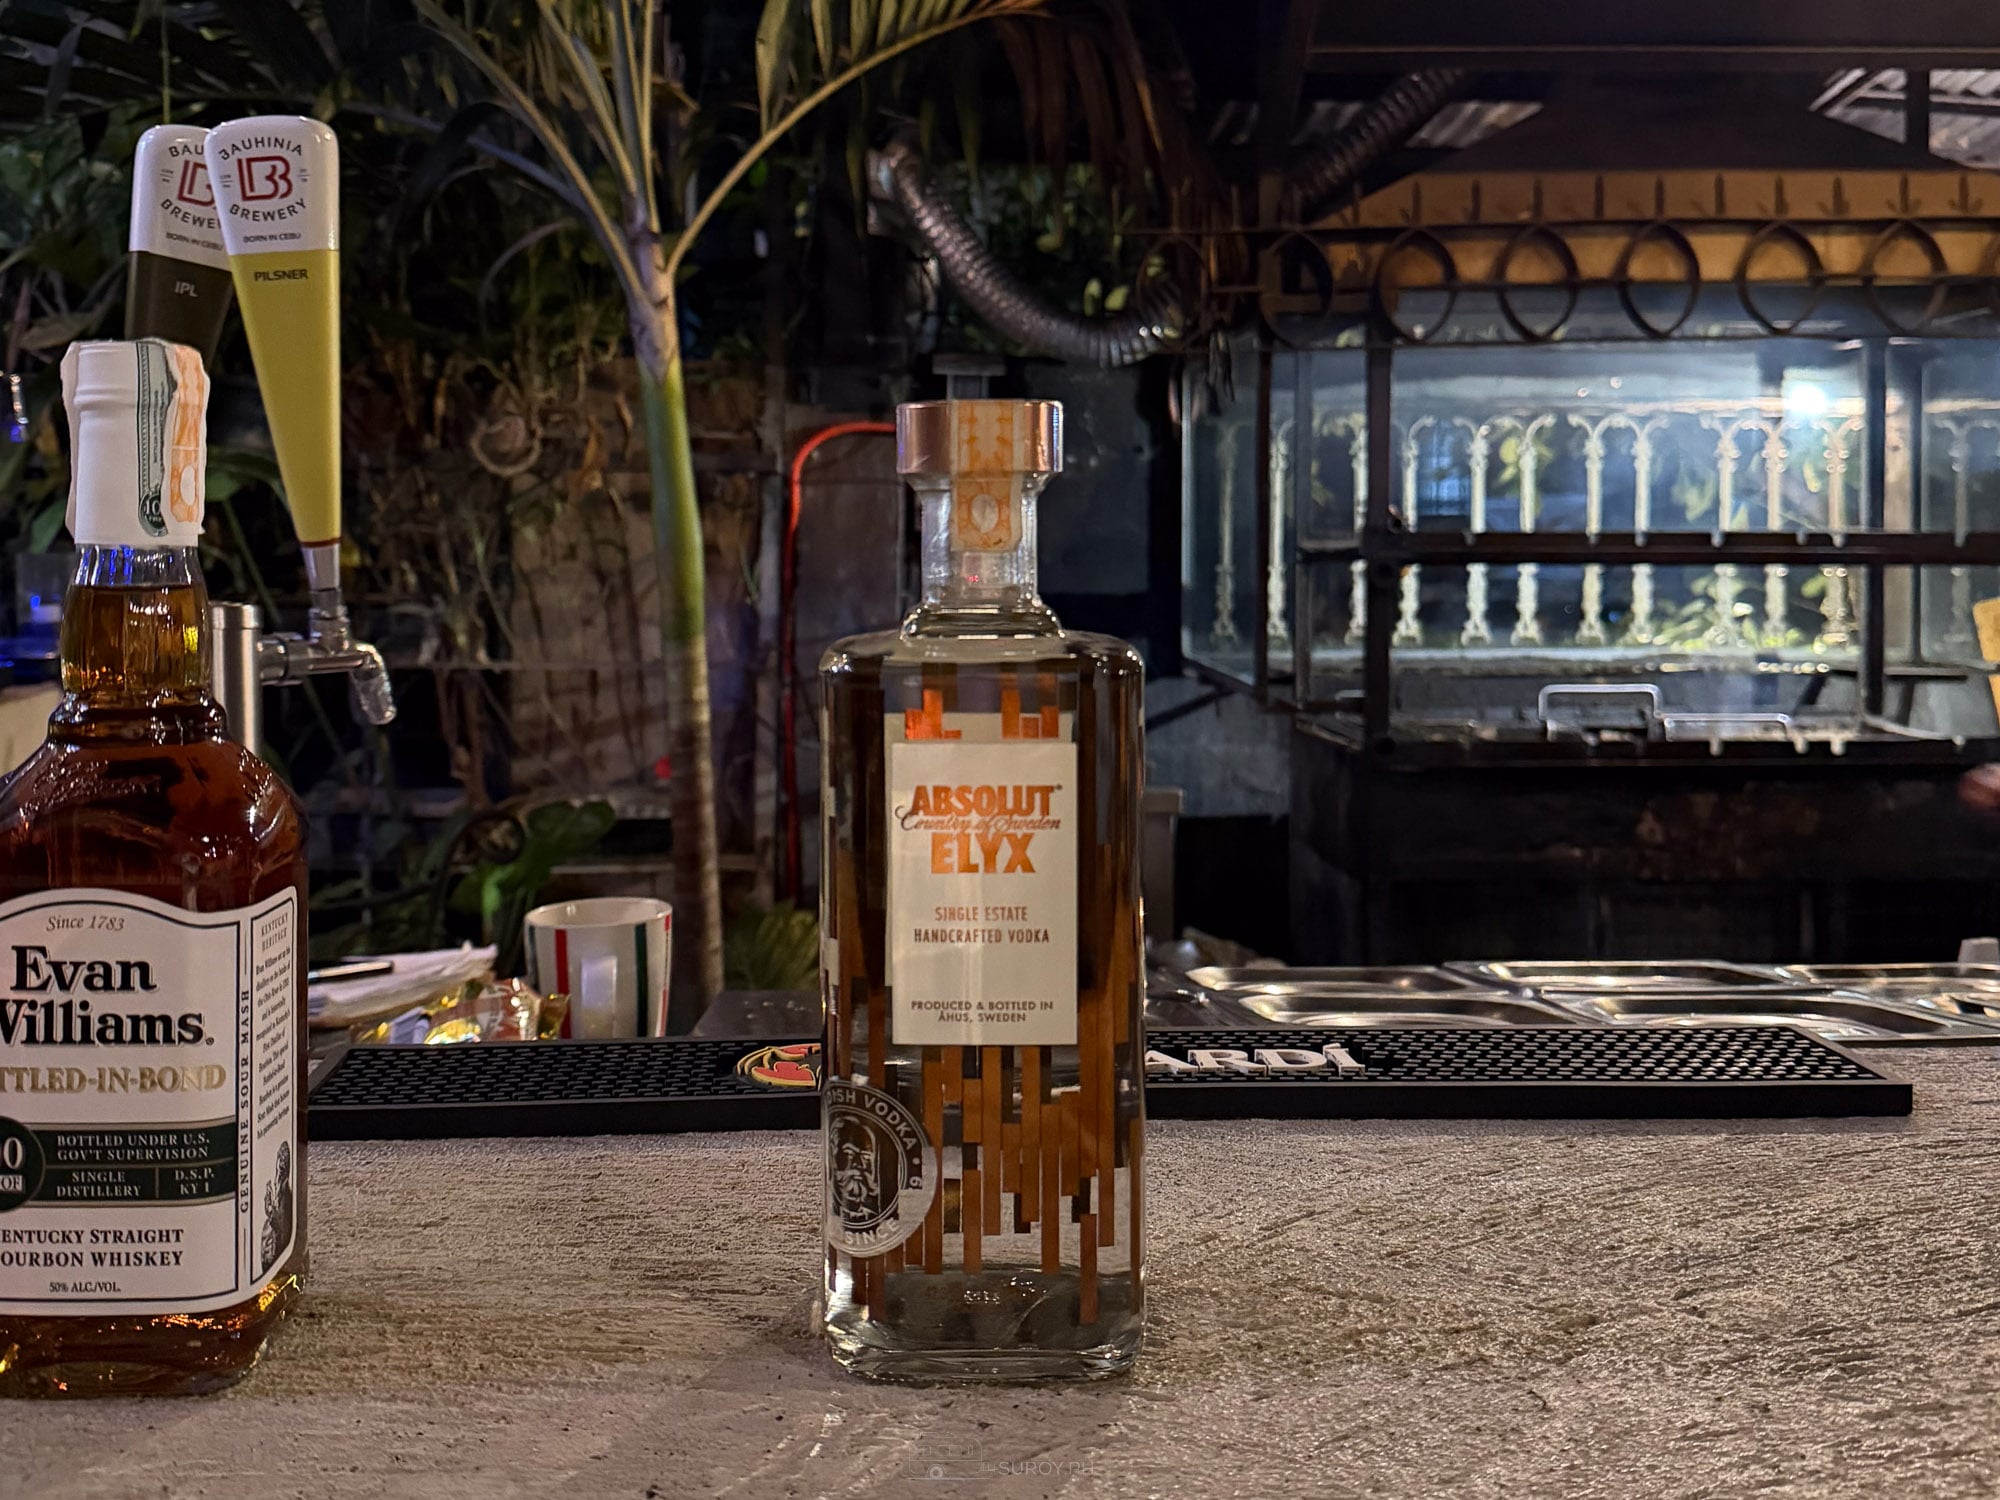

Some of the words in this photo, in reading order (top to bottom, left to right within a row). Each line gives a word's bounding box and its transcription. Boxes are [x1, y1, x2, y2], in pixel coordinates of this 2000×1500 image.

[169, 144, 204, 157] BAU
[219, 137, 303, 160] BAUHINIA
[161, 198, 222, 229] BREWE
[229, 199, 307, 222] BREWERY
[243, 233, 268, 243] BORN
[269, 233, 278, 241] IN
[279, 232, 301, 241] CEBU
[254, 269, 308, 281] PILSNER
[174, 281, 199, 297] IPL
[911, 785, 1055, 816] ABSOLUT
[895, 806, 972, 832] Country
[995, 814, 1060, 832] Sweden
[931, 831, 1036, 874] ELYX
[935, 906, 978, 921] SINGLE
[985, 906, 1028, 921] ESTATE
[46, 915, 84, 932] Since
[89, 915, 125, 931] 1783
[914, 928, 1002, 944] HANDCRAFTED
[1008, 928, 1049, 943] VODKA
[10, 944, 158, 993] Evan
[911, 1001, 972, 1011] PRODUCED
[976, 1001, 984, 1011] &
[989, 1001, 1036, 1010] BOTTLED
[1040, 1001, 1053, 1010] IN
[240, 990, 249, 1044] MASH
[978, 1012, 1026, 1022] SWEDEN
[240, 1056, 249, 1109] SOUR
[864, 1094, 917, 1150] VODKA
[57, 1134, 123, 1147] BOTTLED
[128, 1133, 178, 1146] UNDER
[183, 1133, 210, 1145] U.S.
[57, 1149, 103, 1161] GOV'T
[107, 1147, 209, 1160] SUPERVISION
[240, 1119, 249, 1213] GENUINE
[72, 1171, 126, 1184] SINGLE
[56, 1185, 142, 1198] DISTILLERY
[180, 1183, 199, 1195] KY
[204, 1182, 210, 1194] 1
[0, 1229, 84, 1244] ENTUCKY
[90, 1228, 184, 1244] STRAIGHT
[844, 1217, 899, 1244] SINCE
[1, 1251, 84, 1267] OURBON
[91, 1250, 184, 1267] WHISKEY
[49, 1282, 68, 1293] 50%
